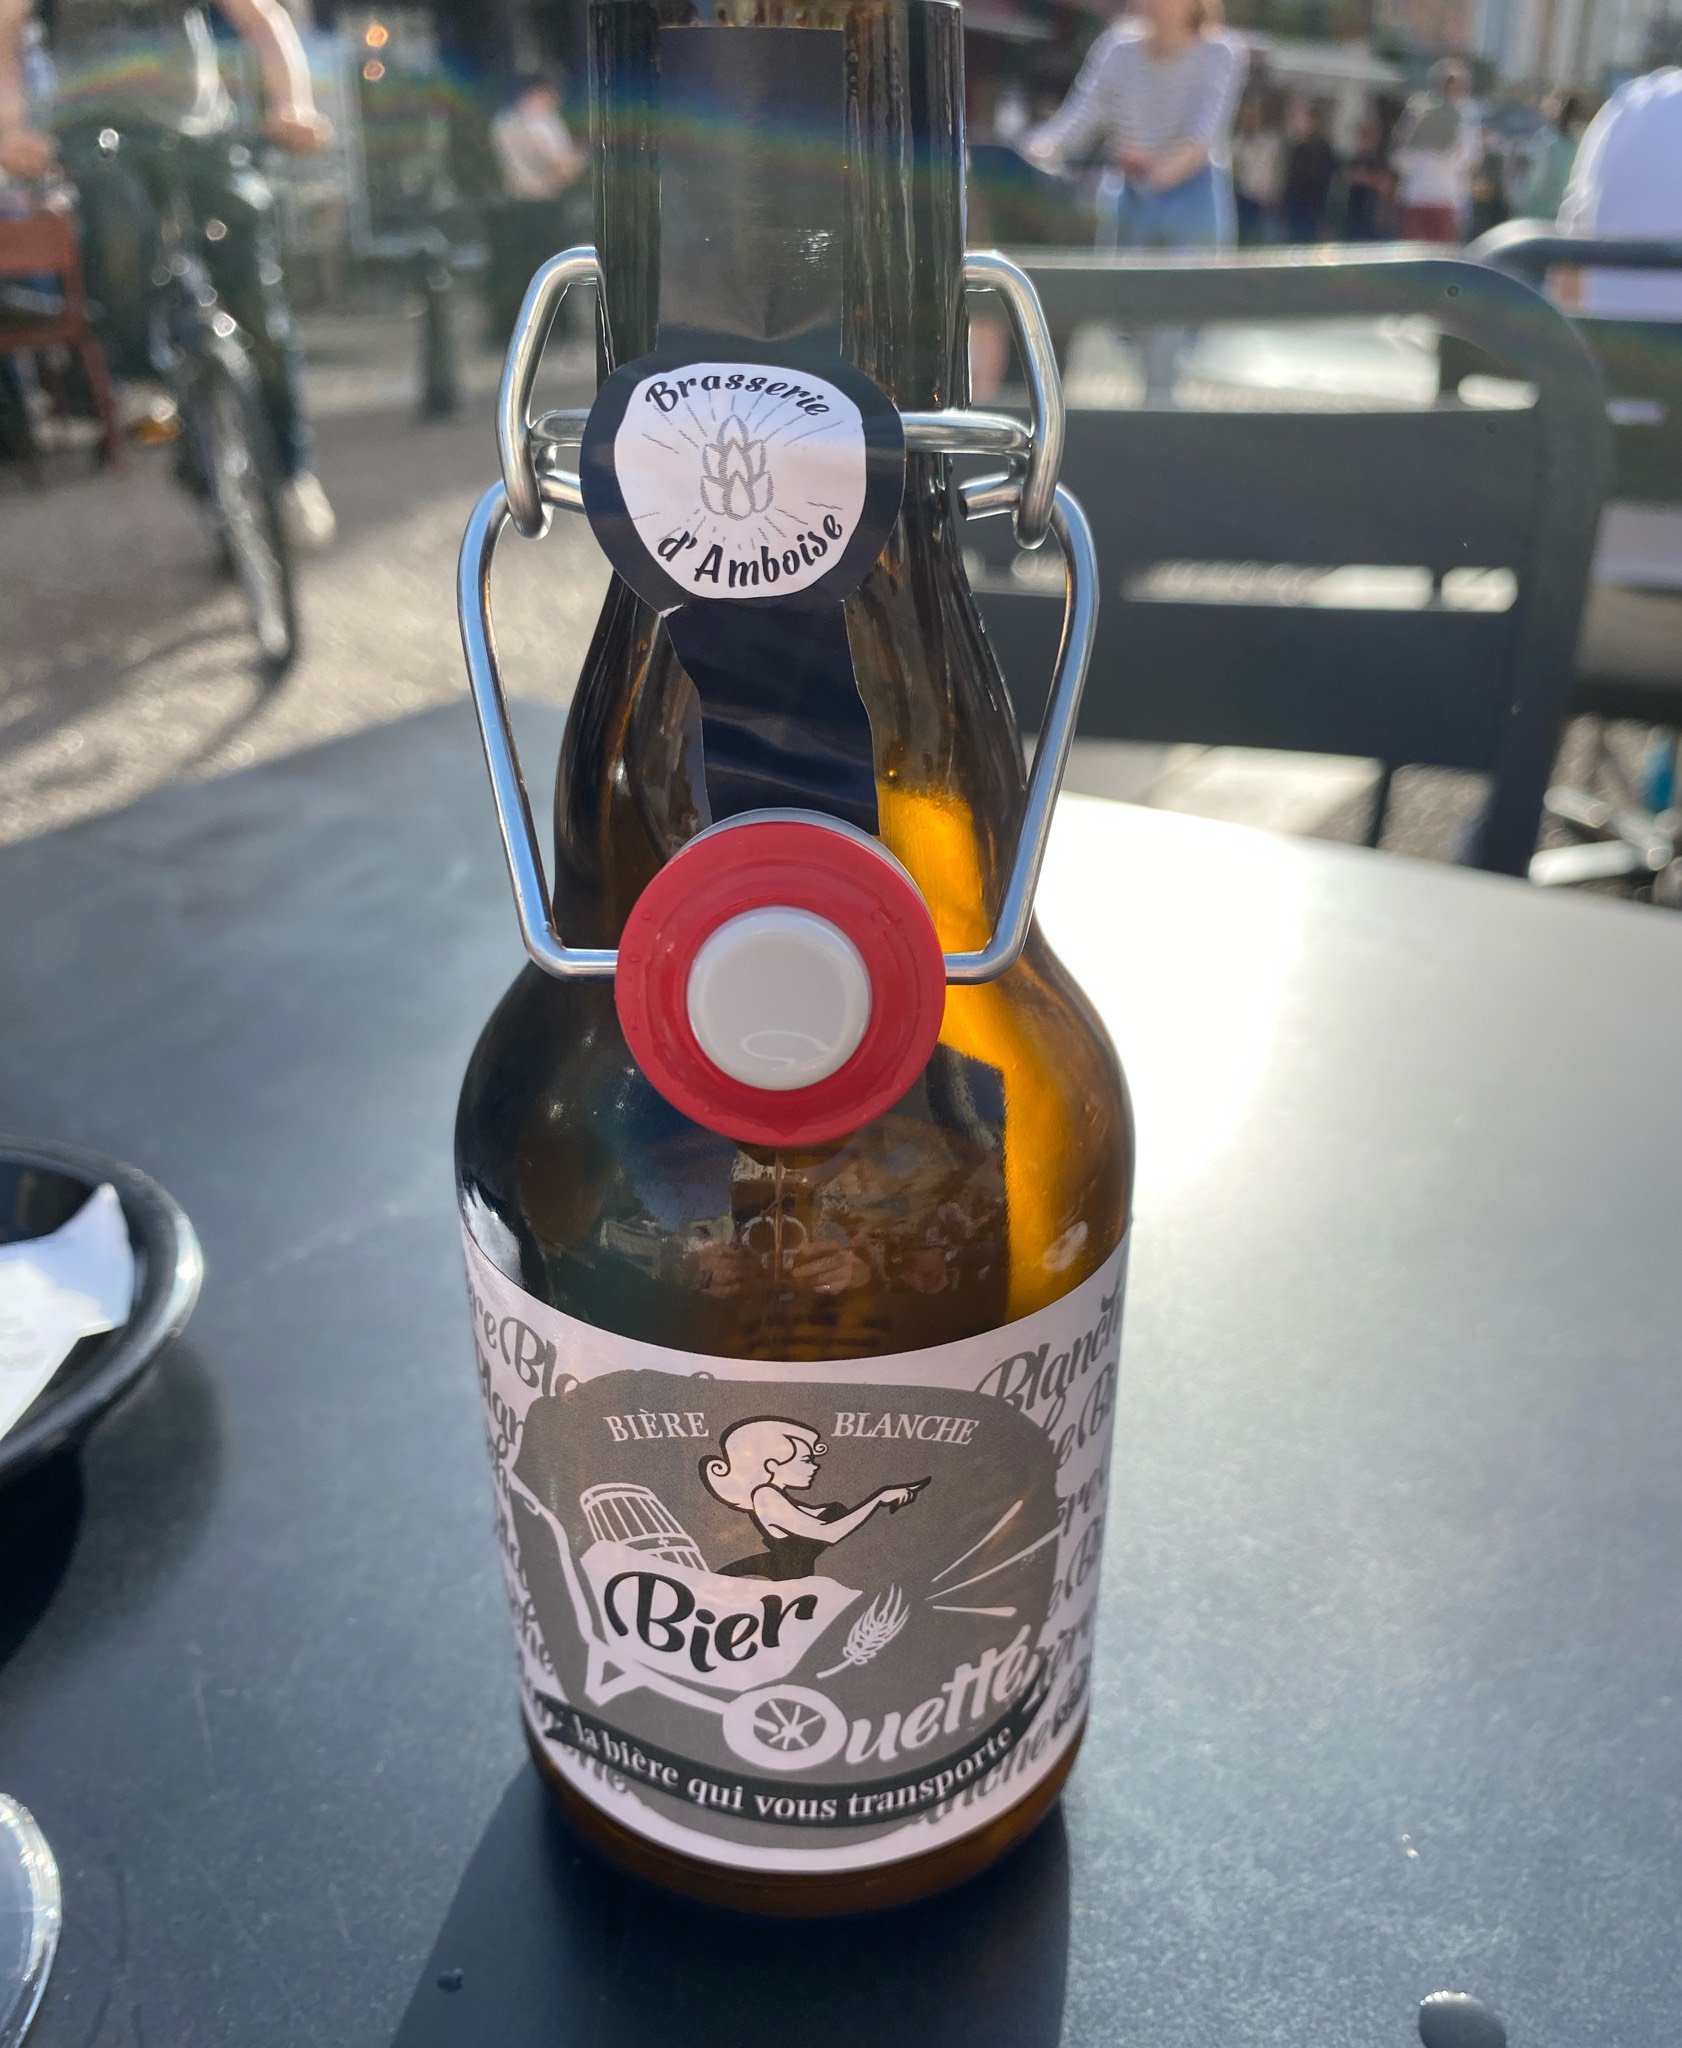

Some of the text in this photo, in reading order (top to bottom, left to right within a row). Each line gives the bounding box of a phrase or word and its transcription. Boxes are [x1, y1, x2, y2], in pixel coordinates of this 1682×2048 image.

[645, 374, 830, 416] Brasserie
[603, 1409, 980, 1445] BIÈRE BLANCHE
[603, 1571, 819, 1672] Bier
[599, 1729, 679, 1786] bière
[687, 1778, 743, 1809] qui
[754, 1794, 837, 1821] vous
[849, 1726, 1013, 1818] transporte
